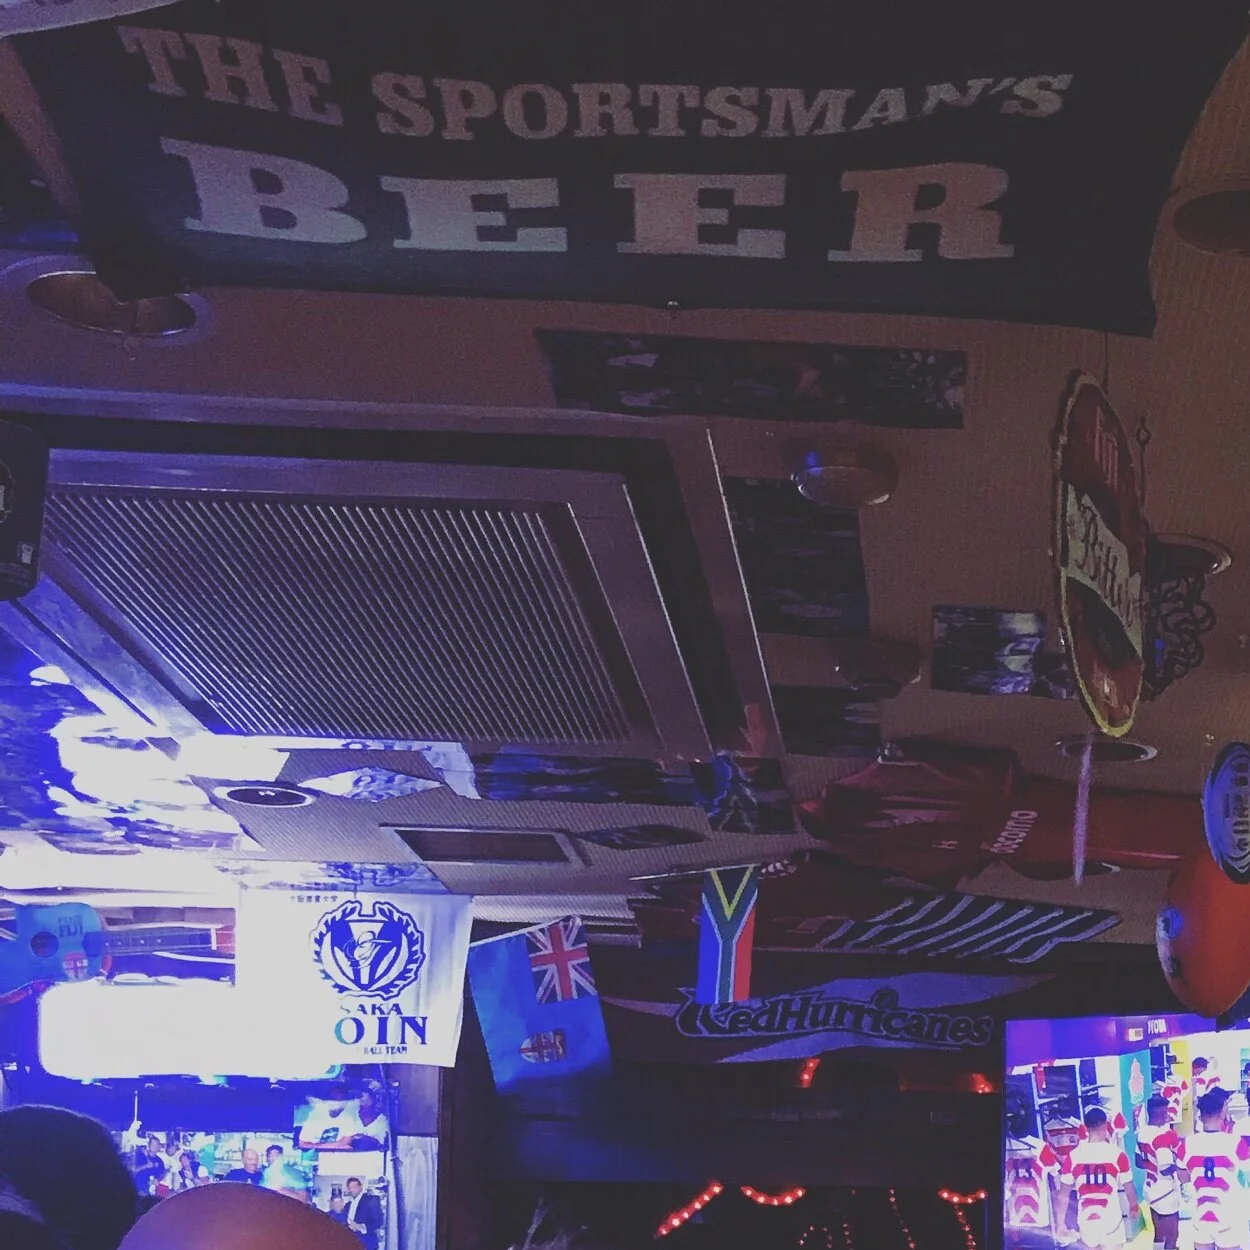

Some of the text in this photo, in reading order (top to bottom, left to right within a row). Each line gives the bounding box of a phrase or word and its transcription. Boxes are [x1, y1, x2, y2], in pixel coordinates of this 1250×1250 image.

[117, 26, 1074, 140] THE SPORTSMAN'S
[160, 136, 1015, 262] BEER
